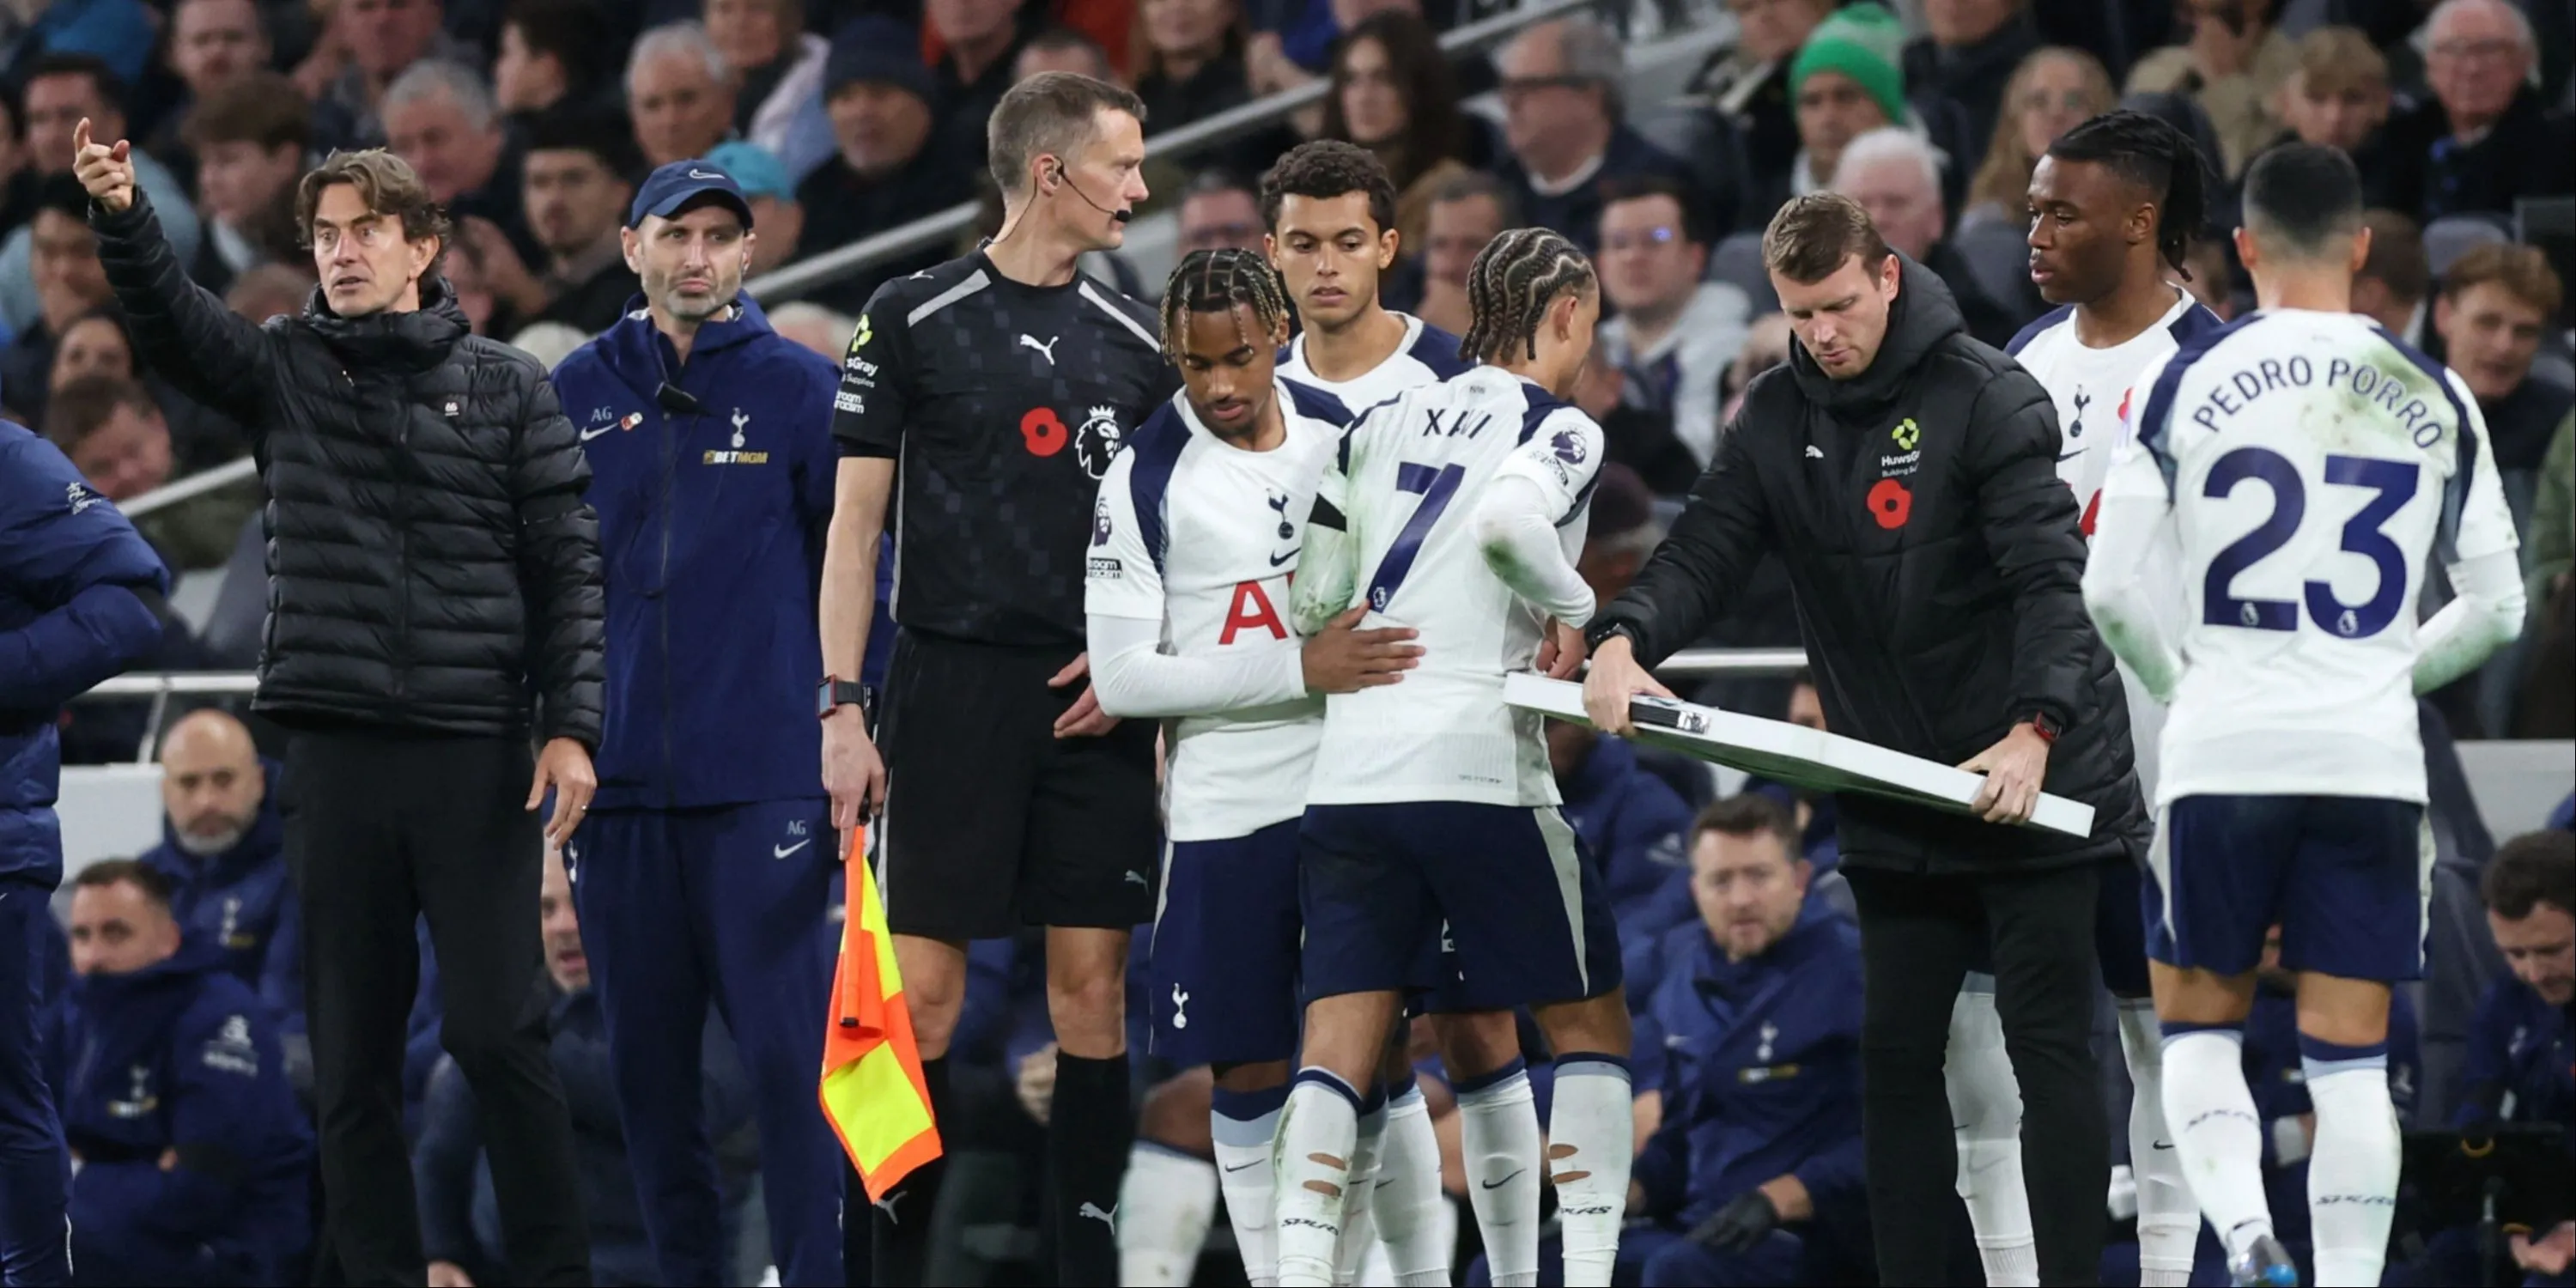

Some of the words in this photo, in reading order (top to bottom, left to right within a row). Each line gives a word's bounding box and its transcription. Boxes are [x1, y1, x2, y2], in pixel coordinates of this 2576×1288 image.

[591, 405, 613, 422] AG
[2192, 355, 2313, 433] PEDRO
[2326, 357, 2443, 450] PORRO
[714, 450, 769, 465] BETMGM
[1365, 459, 1467, 615] 7
[2202, 444, 2420, 640] 23
[1218, 570, 1296, 645] A
[787, 819, 806, 835] AG
